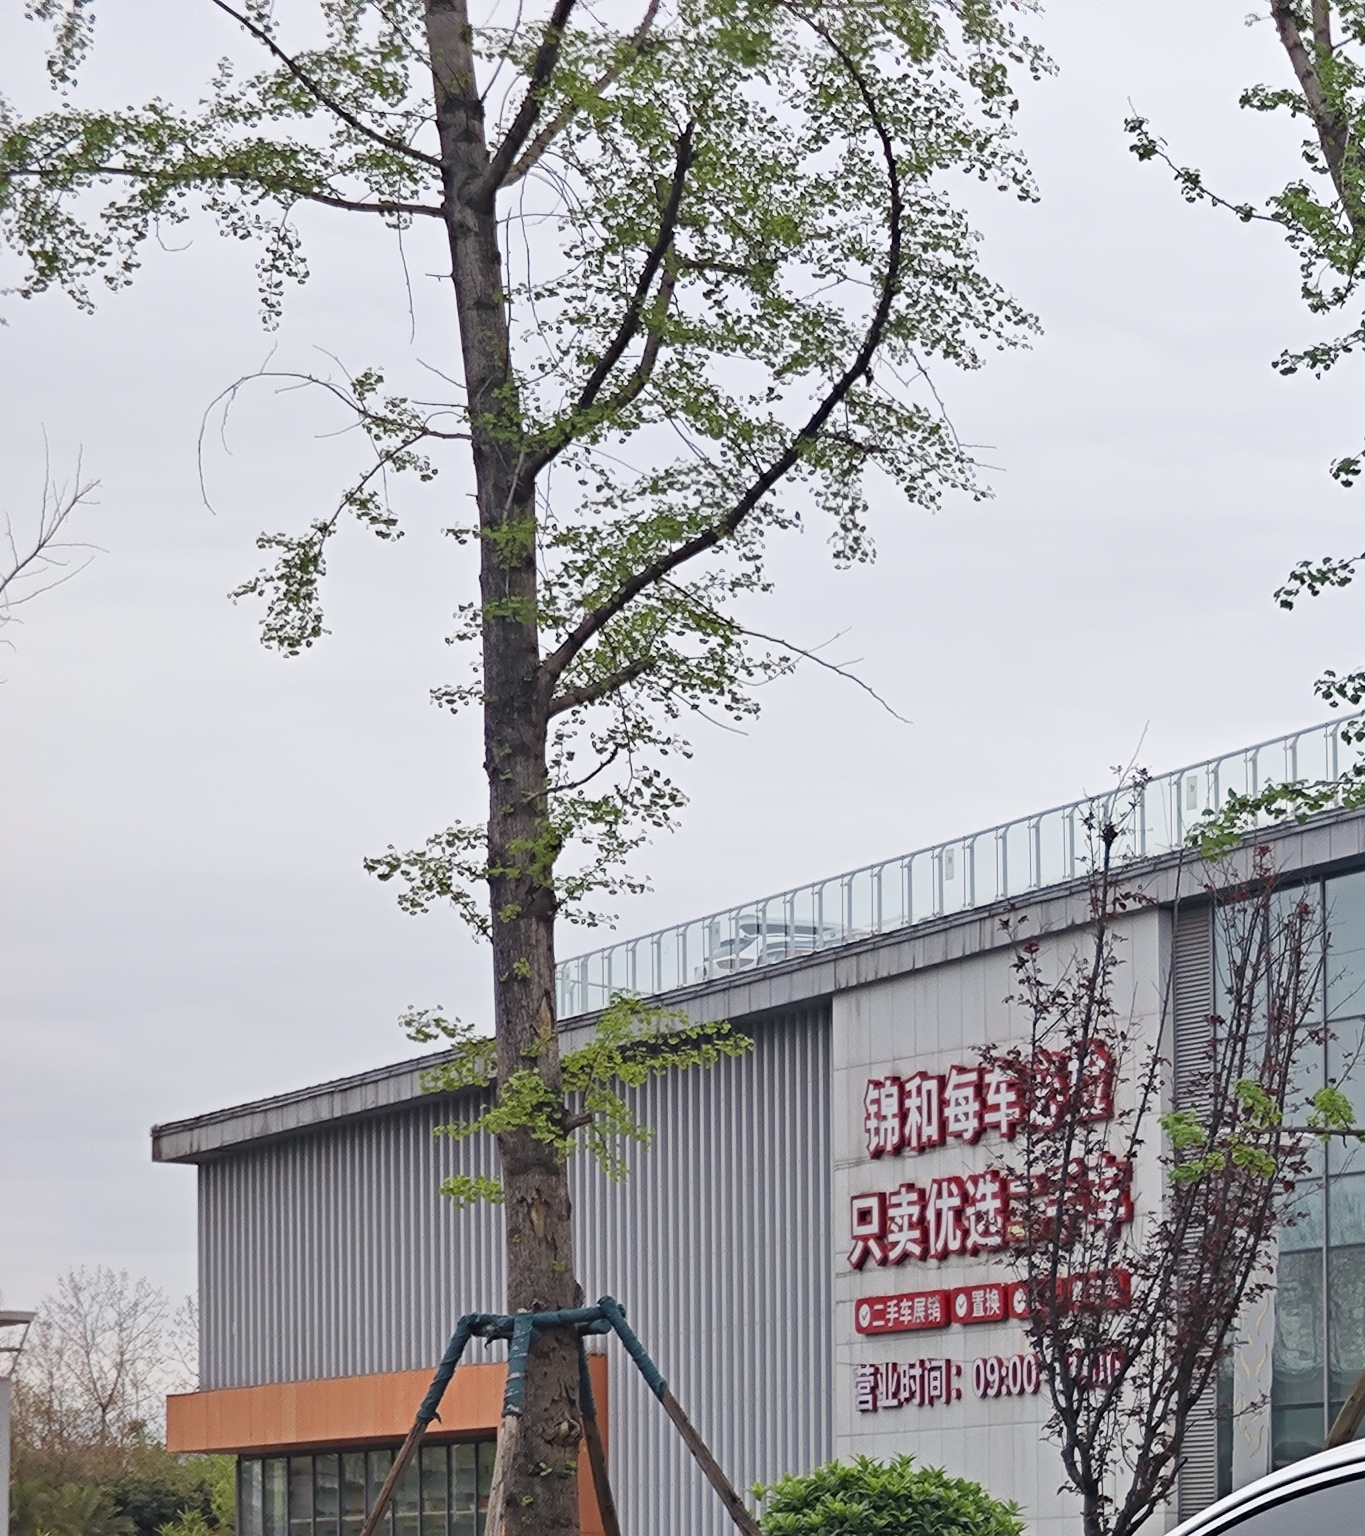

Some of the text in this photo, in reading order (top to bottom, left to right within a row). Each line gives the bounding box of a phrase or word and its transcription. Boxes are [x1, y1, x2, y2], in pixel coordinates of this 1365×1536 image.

[872, 1297, 941, 1328] 二手车展销
[972, 1288, 1000, 1318] 置换
